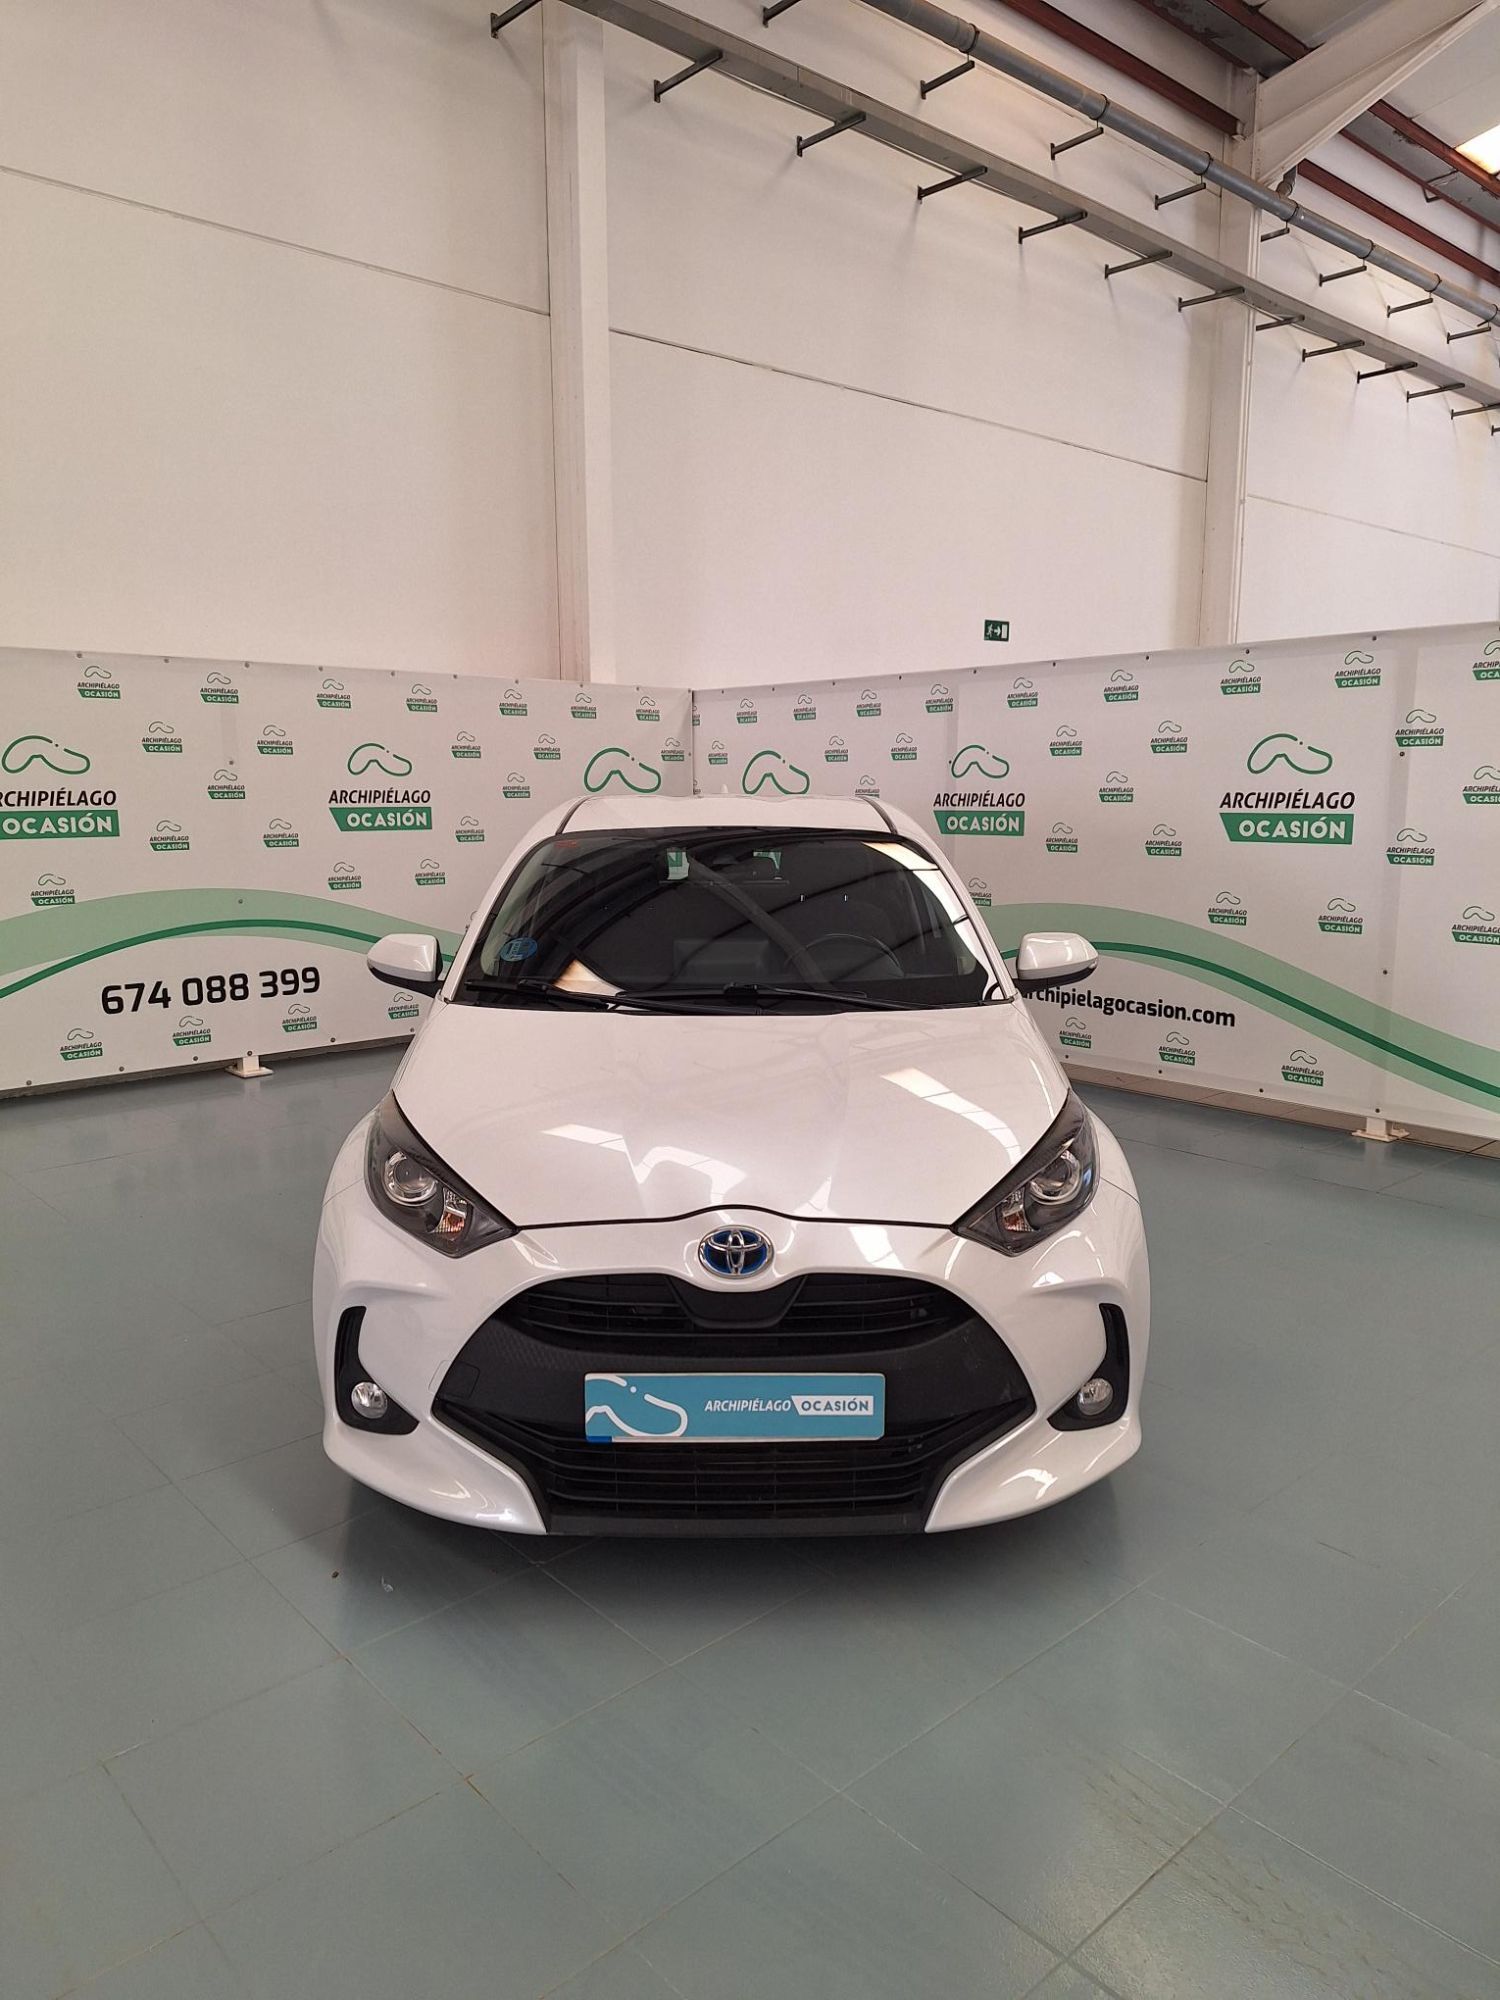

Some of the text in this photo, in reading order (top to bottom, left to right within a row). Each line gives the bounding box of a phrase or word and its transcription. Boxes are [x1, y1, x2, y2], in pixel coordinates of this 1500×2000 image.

[329, 790, 430, 804] ARCHIPIÉLAGO
[933, 791, 1025, 807] ARCHIPIÉLAGO
[1220, 788, 1355, 809] ARCHIPIÉLAGO
[2, 813, 112, 834] OCASIÓN
[347, 810, 428, 827] OCASIÓN
[946, 816, 1019, 832] OCASIÓN
[1239, 817, 1346, 839] OCASIÓN
[102, 966, 320, 1014] 674 088 399
[704, 1398, 869, 1412] ARCHIPIÉLAGO OCASIÓN
